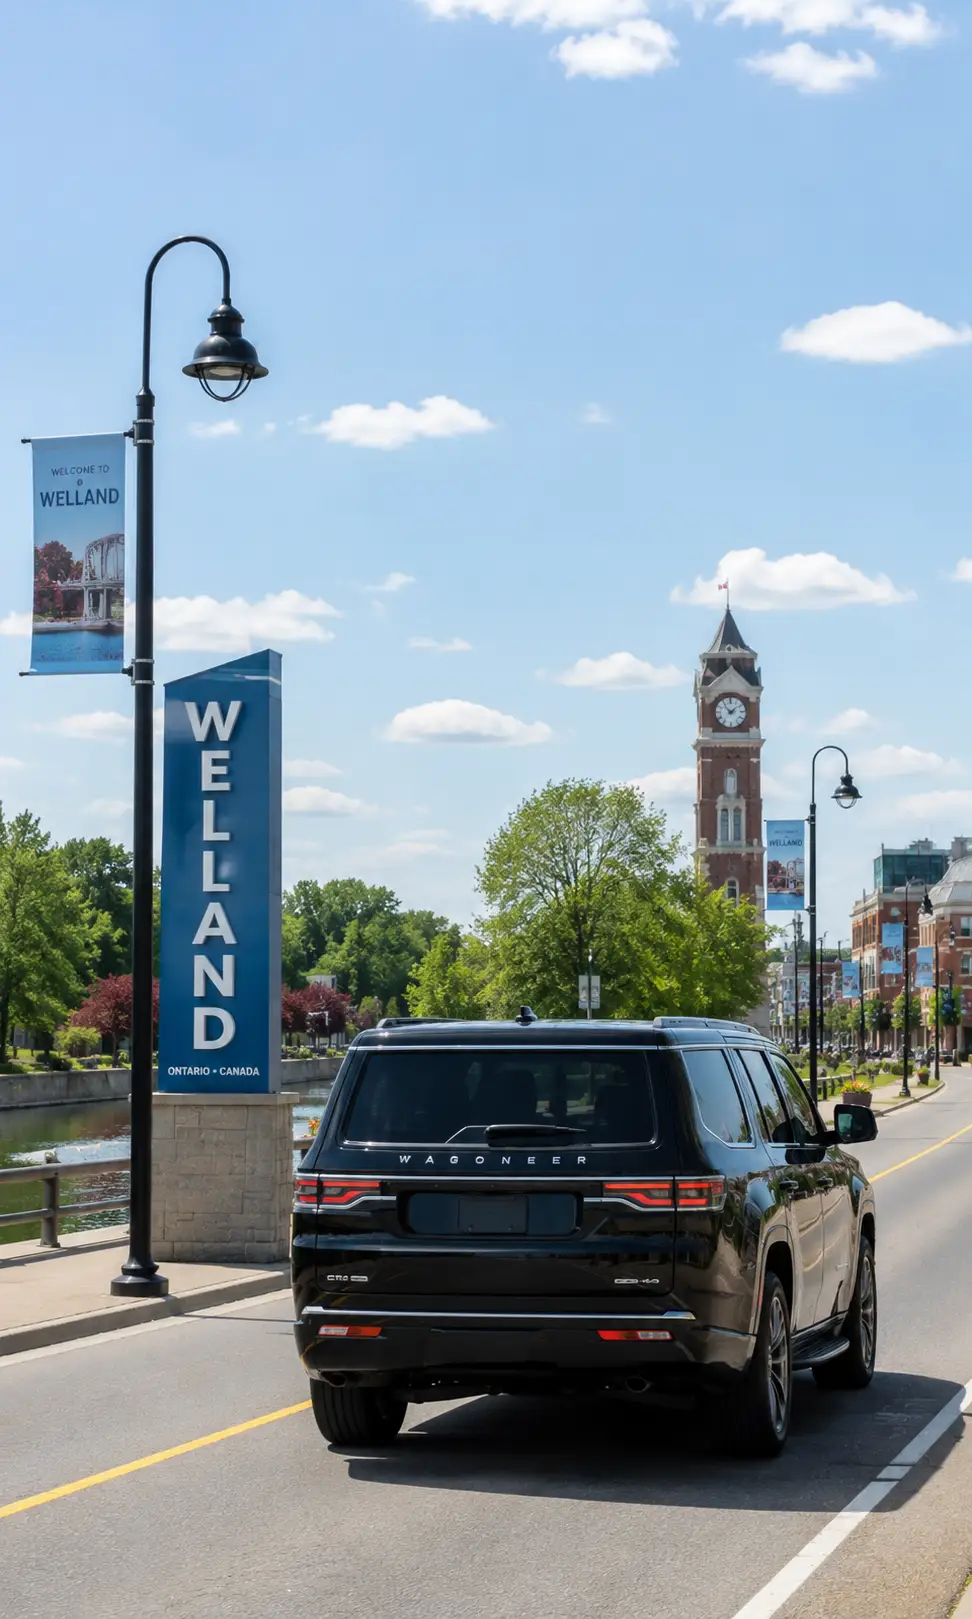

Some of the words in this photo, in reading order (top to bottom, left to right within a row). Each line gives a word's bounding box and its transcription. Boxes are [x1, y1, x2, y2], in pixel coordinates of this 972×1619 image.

[98, 464, 110, 474] TO
[40, 488, 119, 507] WELLAND
[184, 700, 242, 1050] WELLAND
[167, 1066, 210, 1076] ONTARIO
[219, 1066, 260, 1076] CANADA
[399, 1155, 587, 1165] WAGONEER
